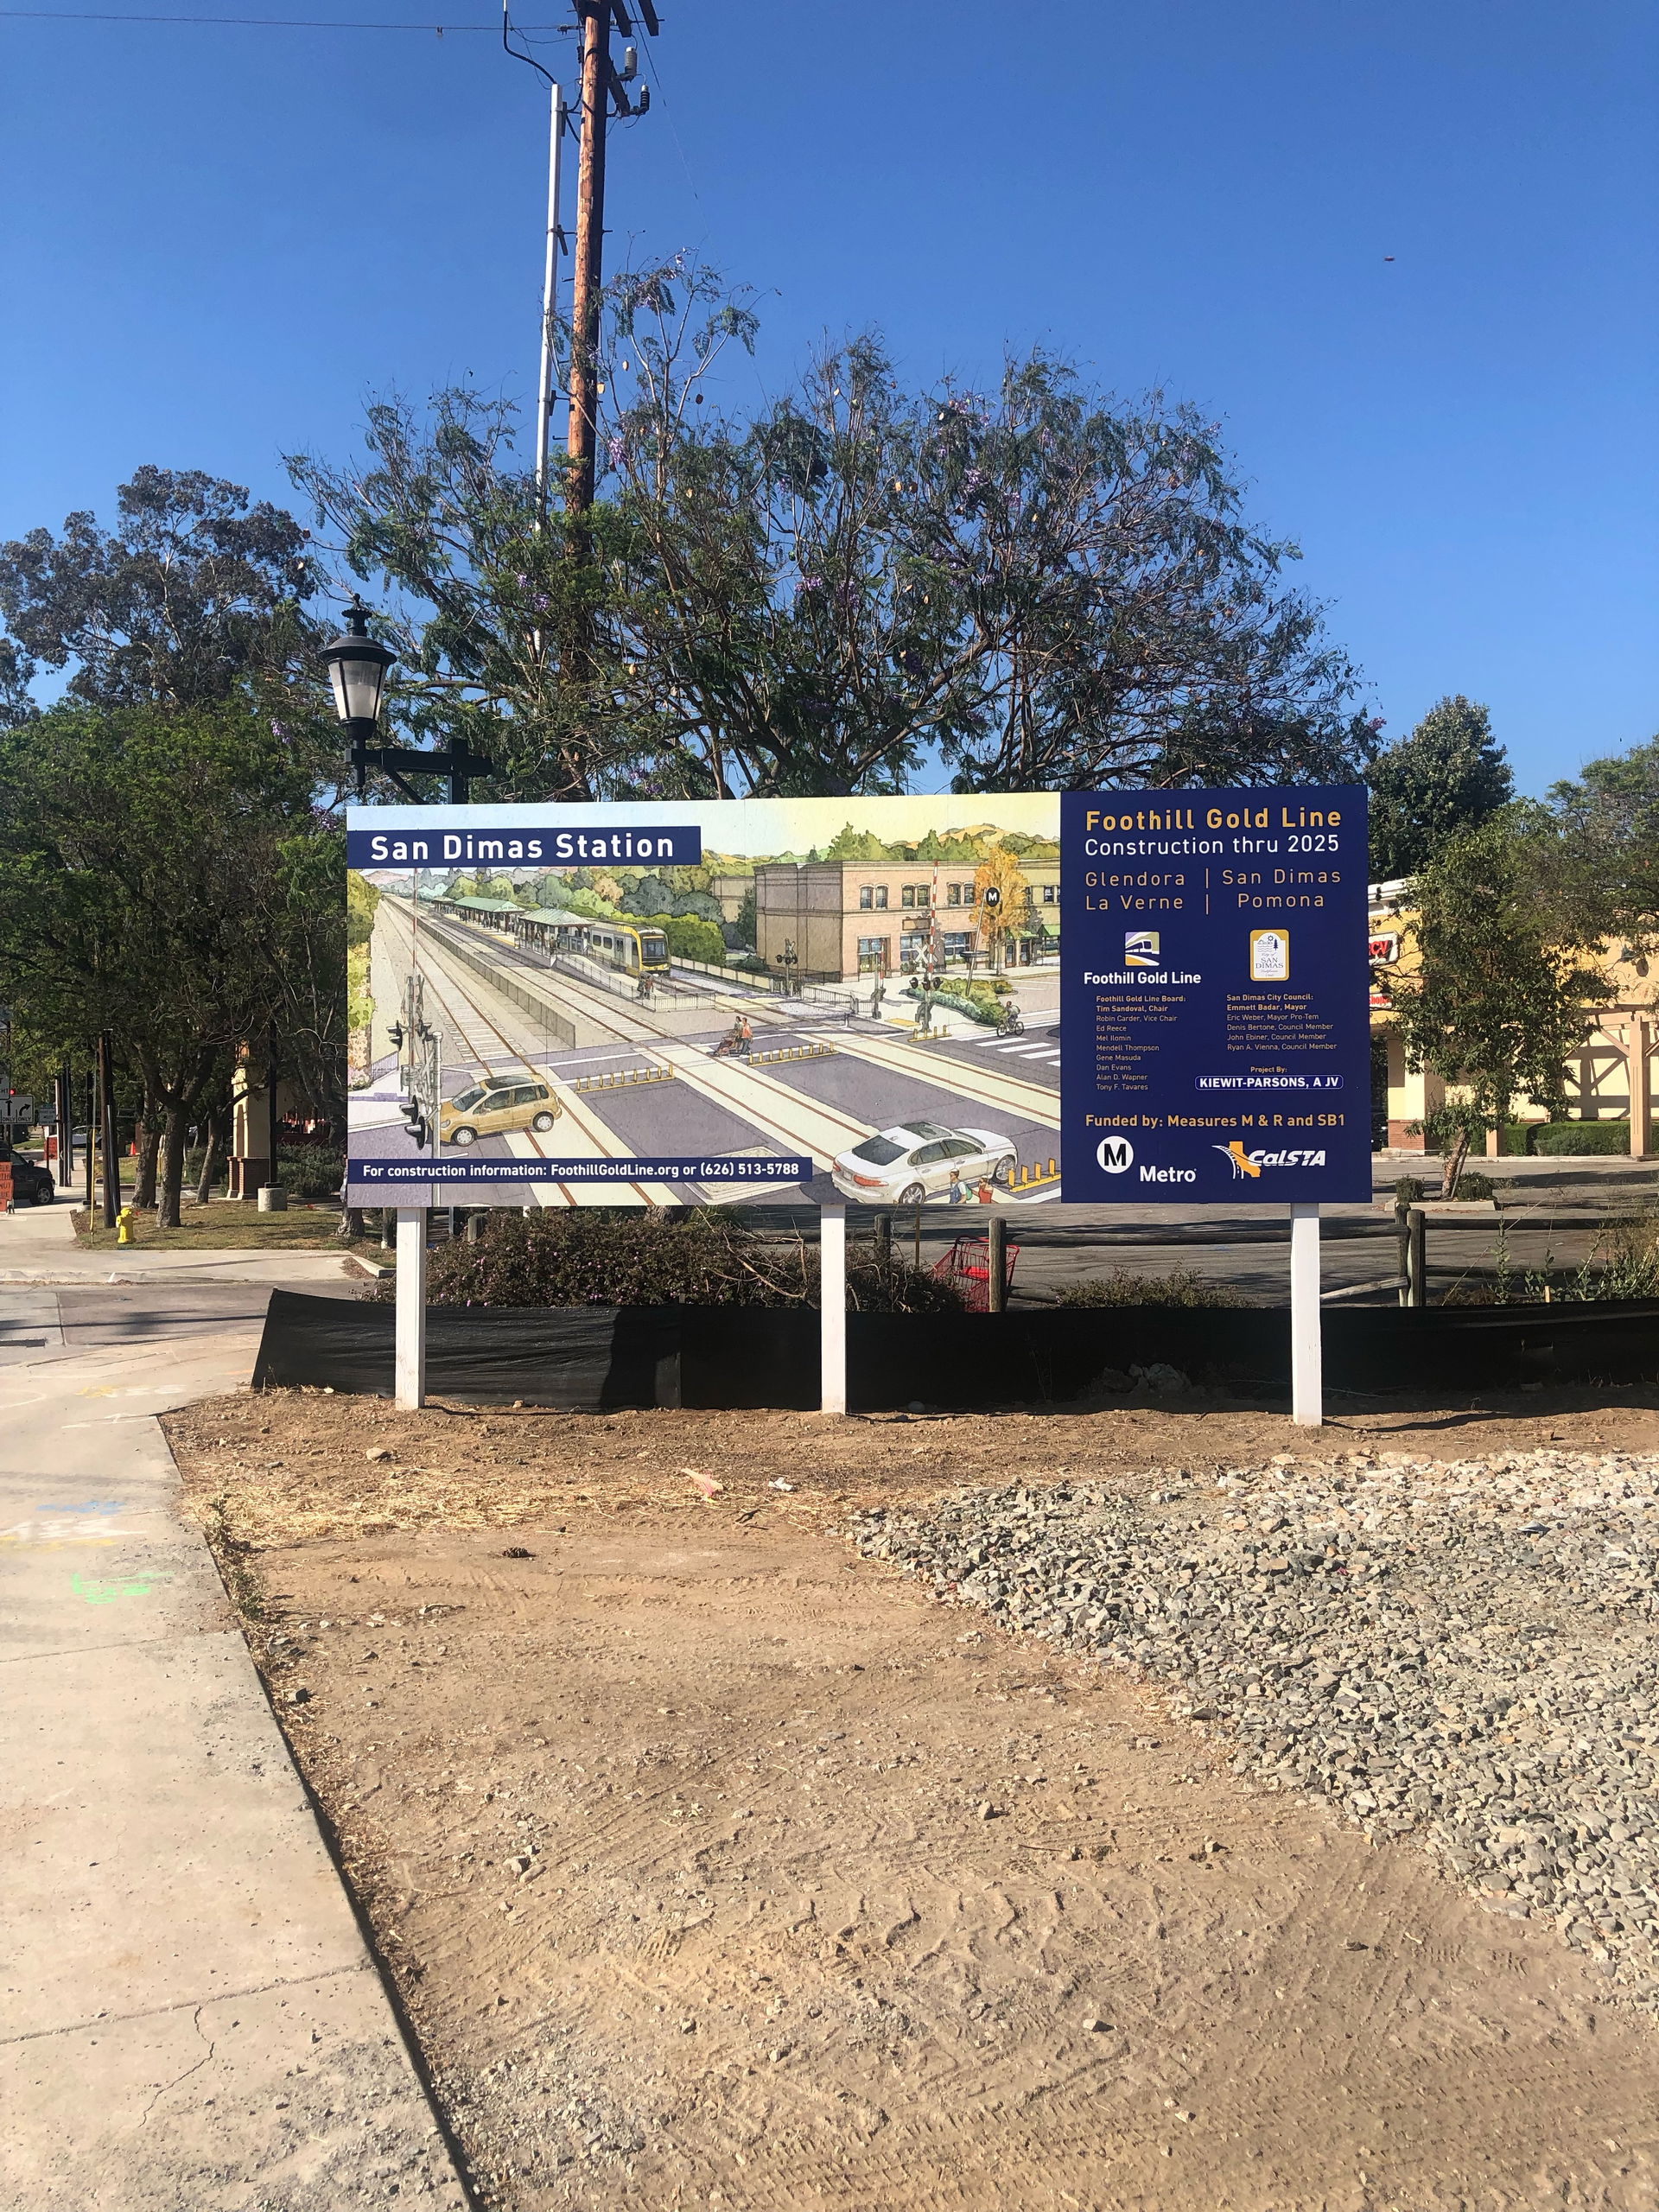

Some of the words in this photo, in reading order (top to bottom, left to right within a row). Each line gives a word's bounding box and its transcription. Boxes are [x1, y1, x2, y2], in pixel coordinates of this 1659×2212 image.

[1085, 809, 1195, 831] Foothill
[1206, 807, 1269, 830] Gold
[1281, 806, 1342, 828] Line
[370, 836, 429, 861] San
[442, 834, 543, 861] Dimas
[555, 832, 674, 859] Station
[1084, 836, 1224, 856] Construction
[1232, 836, 1279, 854] thru
[1287, 834, 1339, 853] 2025
[1084, 871, 1185, 887] Glendora
[1222, 869, 1262, 886] San
[1274, 867, 1341, 885] Dimas
[988, 892, 997, 901] M
[1085, 894, 1109, 911] La
[1120, 894, 1184, 911] Verne
[1237, 893, 1325, 908] Pomona
[1084, 971, 1135, 984] Foothill
[1137, 971, 1168, 984] Gold
[1171, 971, 1202, 984] Line
[1284, 1003, 1307, 1012] Mayor
[1122, 1073, 1147, 1082] Wapner
[1199, 1077, 1309, 1090] KIEWIT-PARSONS,
[1313, 1077, 1322, 1087] A
[1325, 1077, 1339, 1087] JV
[1084, 1115, 1138, 1127] Funded
[1141, 1116, 1164, 1129] by:
[1167, 1114, 1237, 1127] Measures
[1242, 1115, 1254, 1127] M
[1258, 1114, 1268, 1126] &
[1274, 1115, 1282, 1126] R
[1287, 1114, 1313, 1126] and
[1317, 1114, 1345, 1126] SB1
[1103, 1143, 1127, 1166] M
[362, 1164, 385, 1178] For
[387, 1164, 467, 1177] construction
[470, 1163, 547, 1177] information:
[550, 1162, 678, 1179] FoothillGoldLine.org
[683, 1164, 696, 1175] or
[700, 1161, 734, 1179] (626)
[738, 1163, 799, 1175] 513-5788
[1140, 1166, 1196, 1183] Metro
